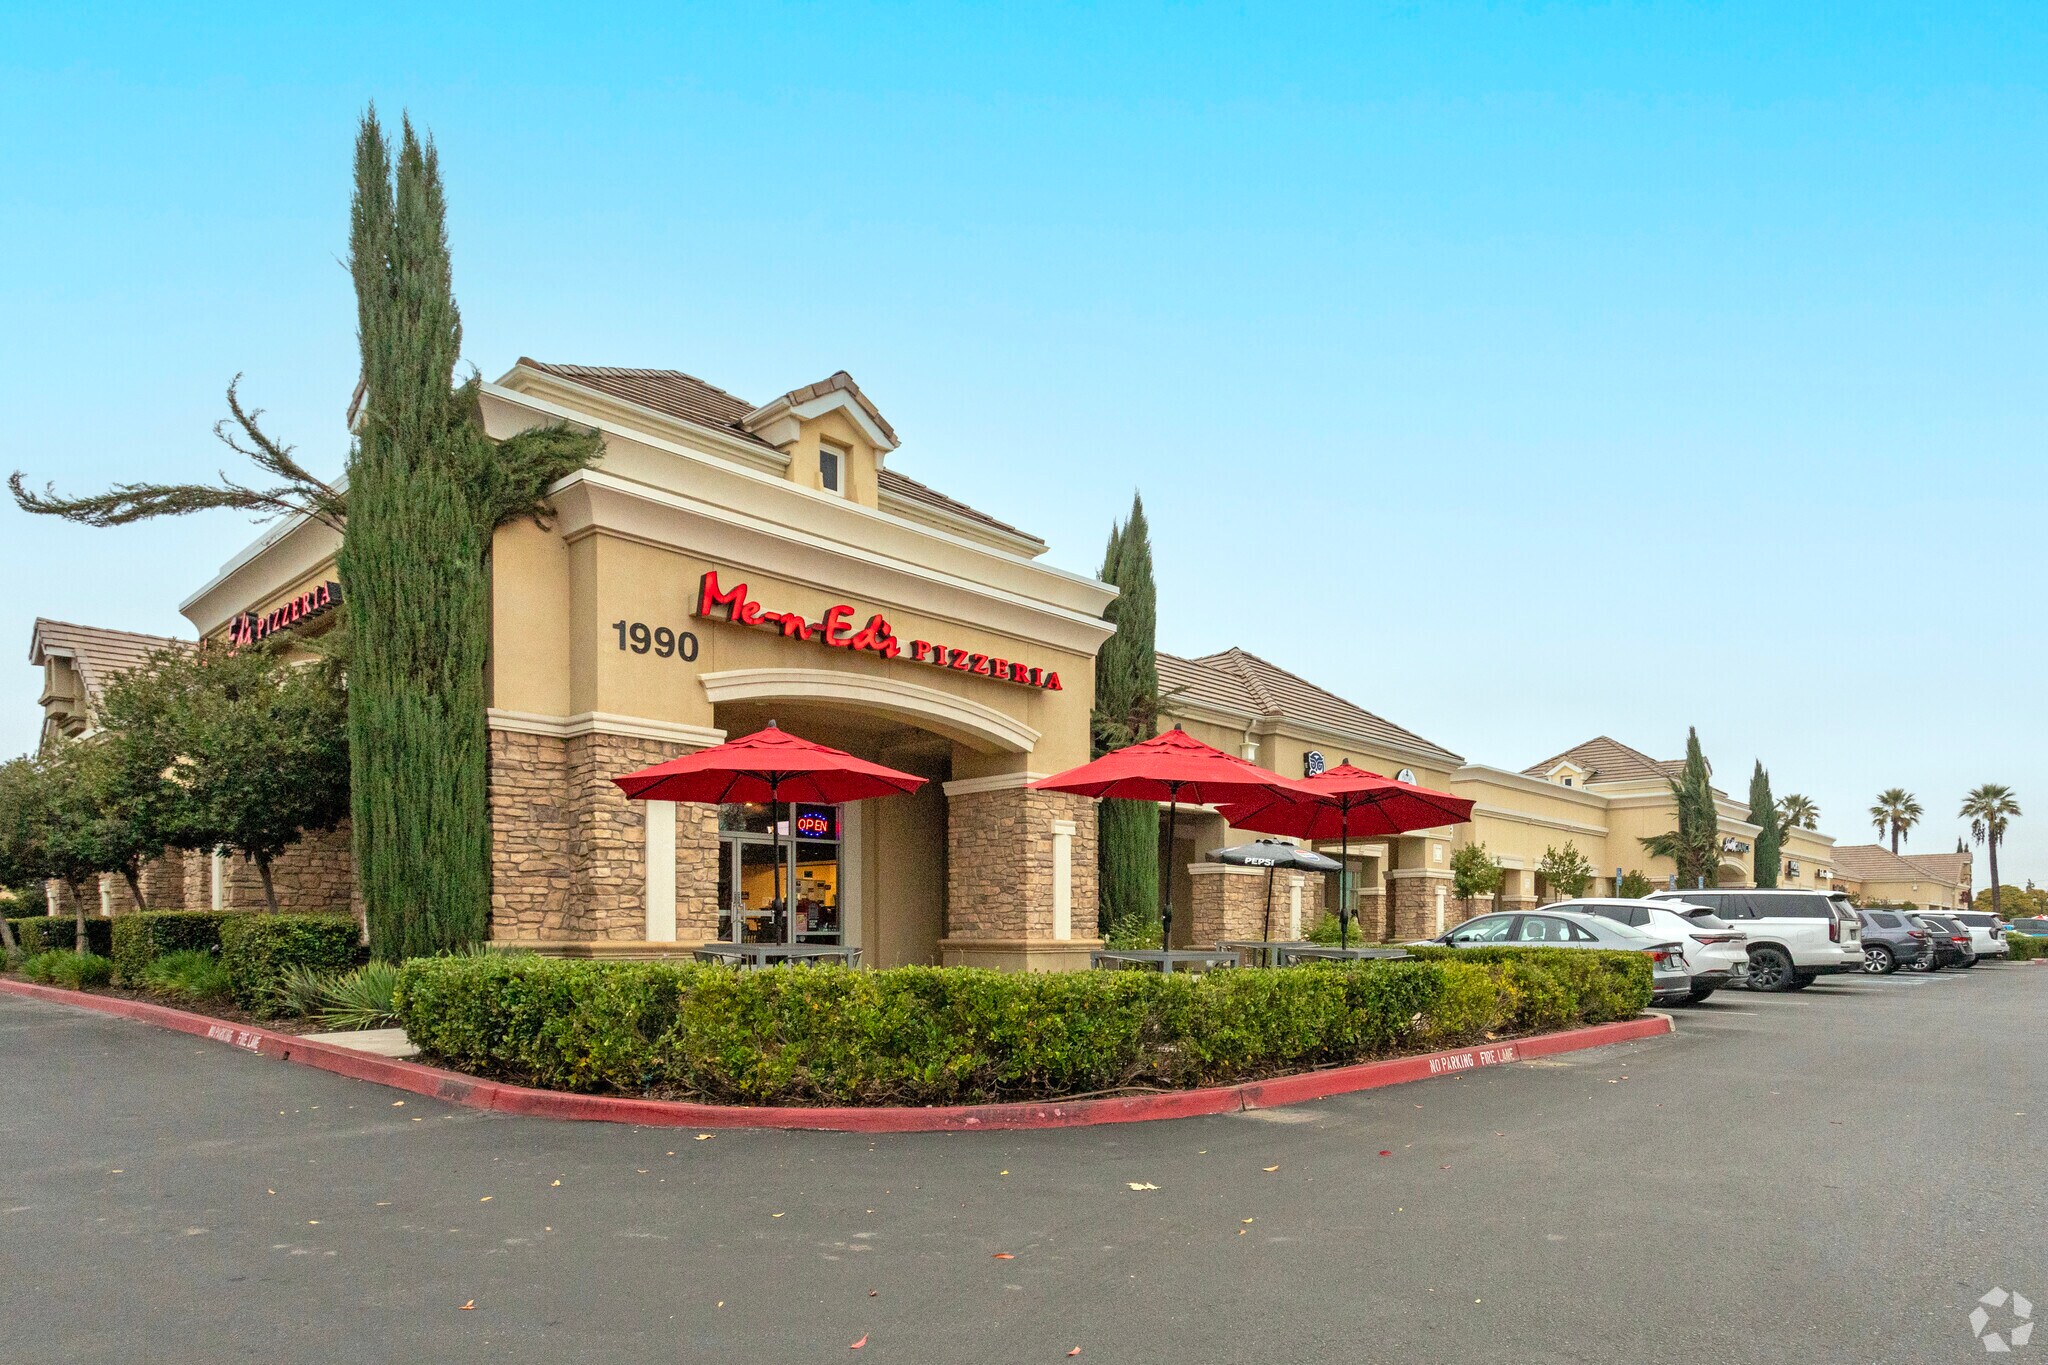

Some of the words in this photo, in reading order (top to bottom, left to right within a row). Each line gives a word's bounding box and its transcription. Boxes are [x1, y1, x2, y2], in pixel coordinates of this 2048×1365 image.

[257, 581, 331, 639] PIZZERIA
[613, 620, 699, 662] 1990
[913, 639, 1063, 692] PIZZERIA
[798, 819, 828, 832] OPEN
[1244, 857, 1275, 866] PEPSI
[1429, 1058, 1441, 1073] NO
[1441, 1053, 1474, 1072] PARKING
[1480, 1050, 1496, 1065] FIRE
